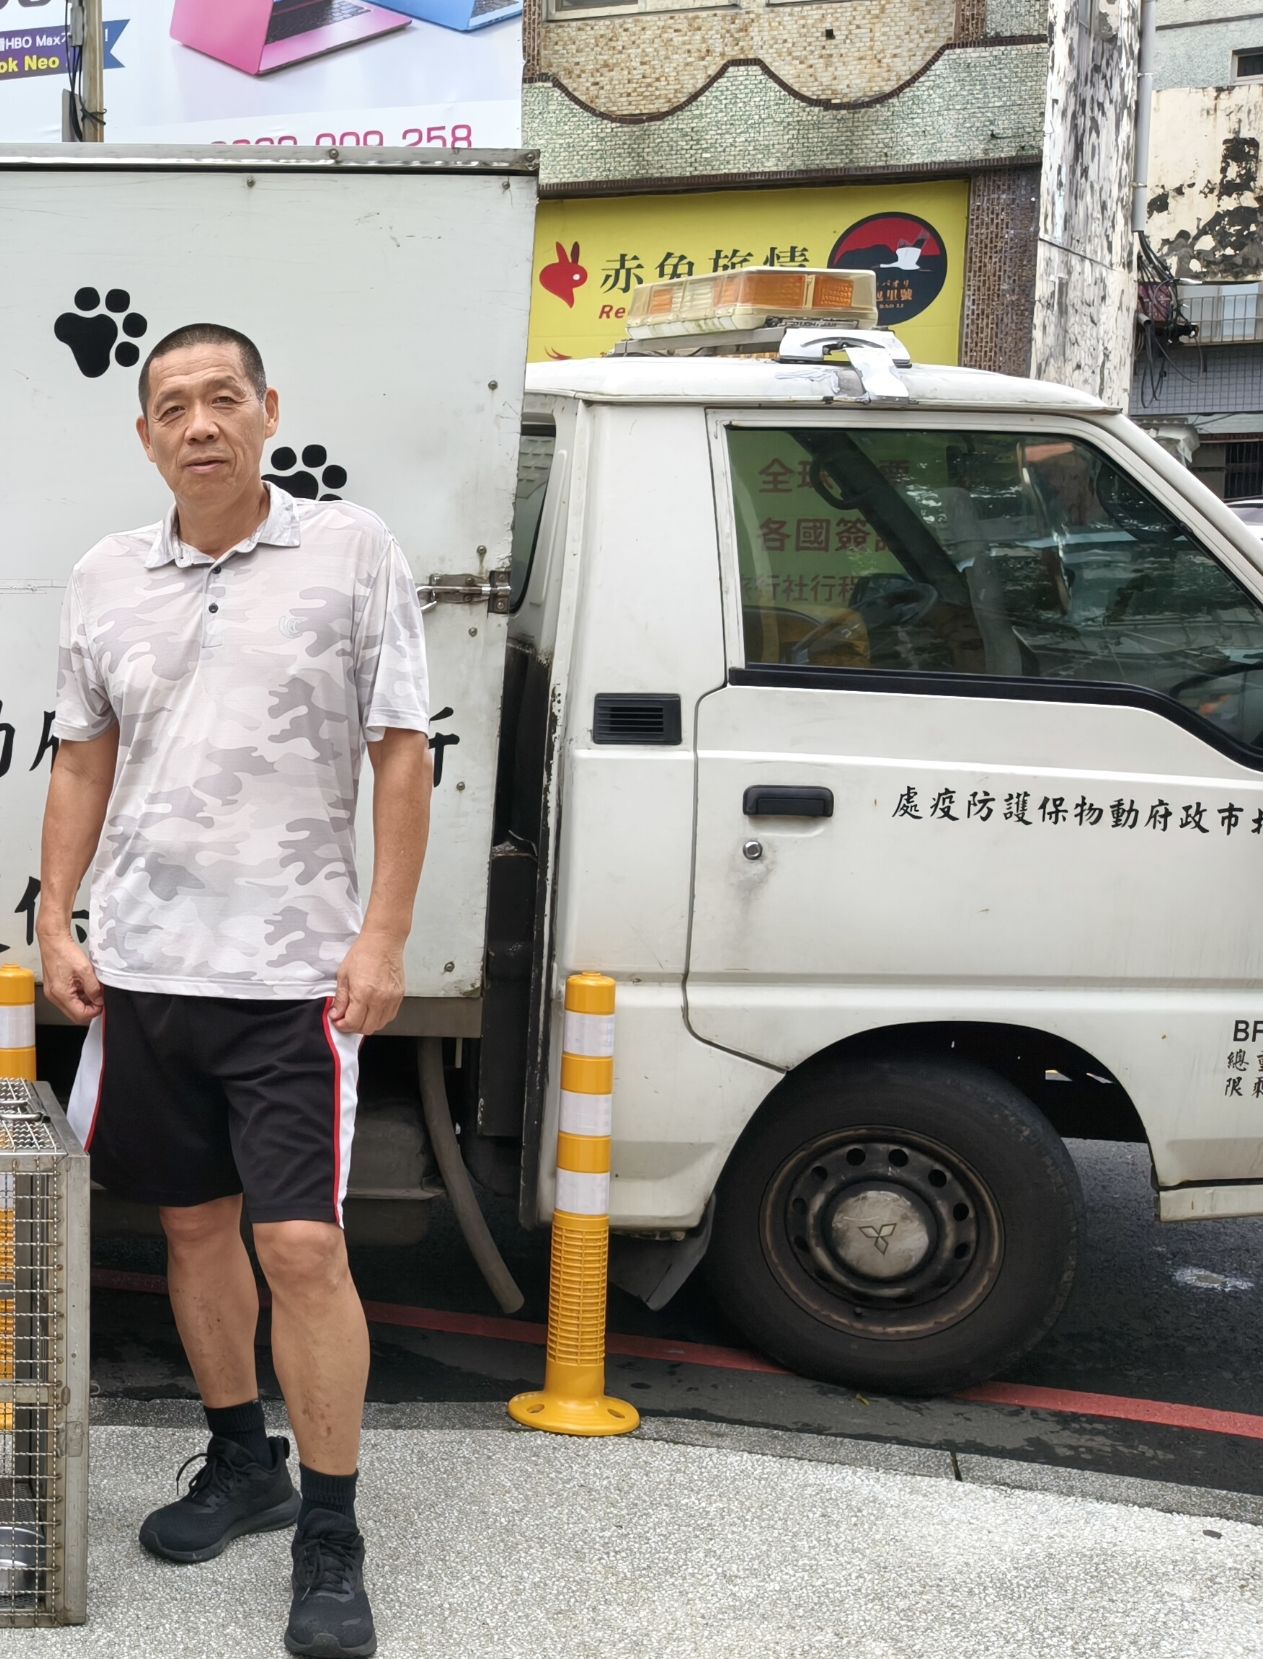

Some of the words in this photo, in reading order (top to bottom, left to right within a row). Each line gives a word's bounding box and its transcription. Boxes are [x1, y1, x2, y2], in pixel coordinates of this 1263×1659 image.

[24, 55, 60, 72] Neo
[758, 516, 891, 553] 各國簽
